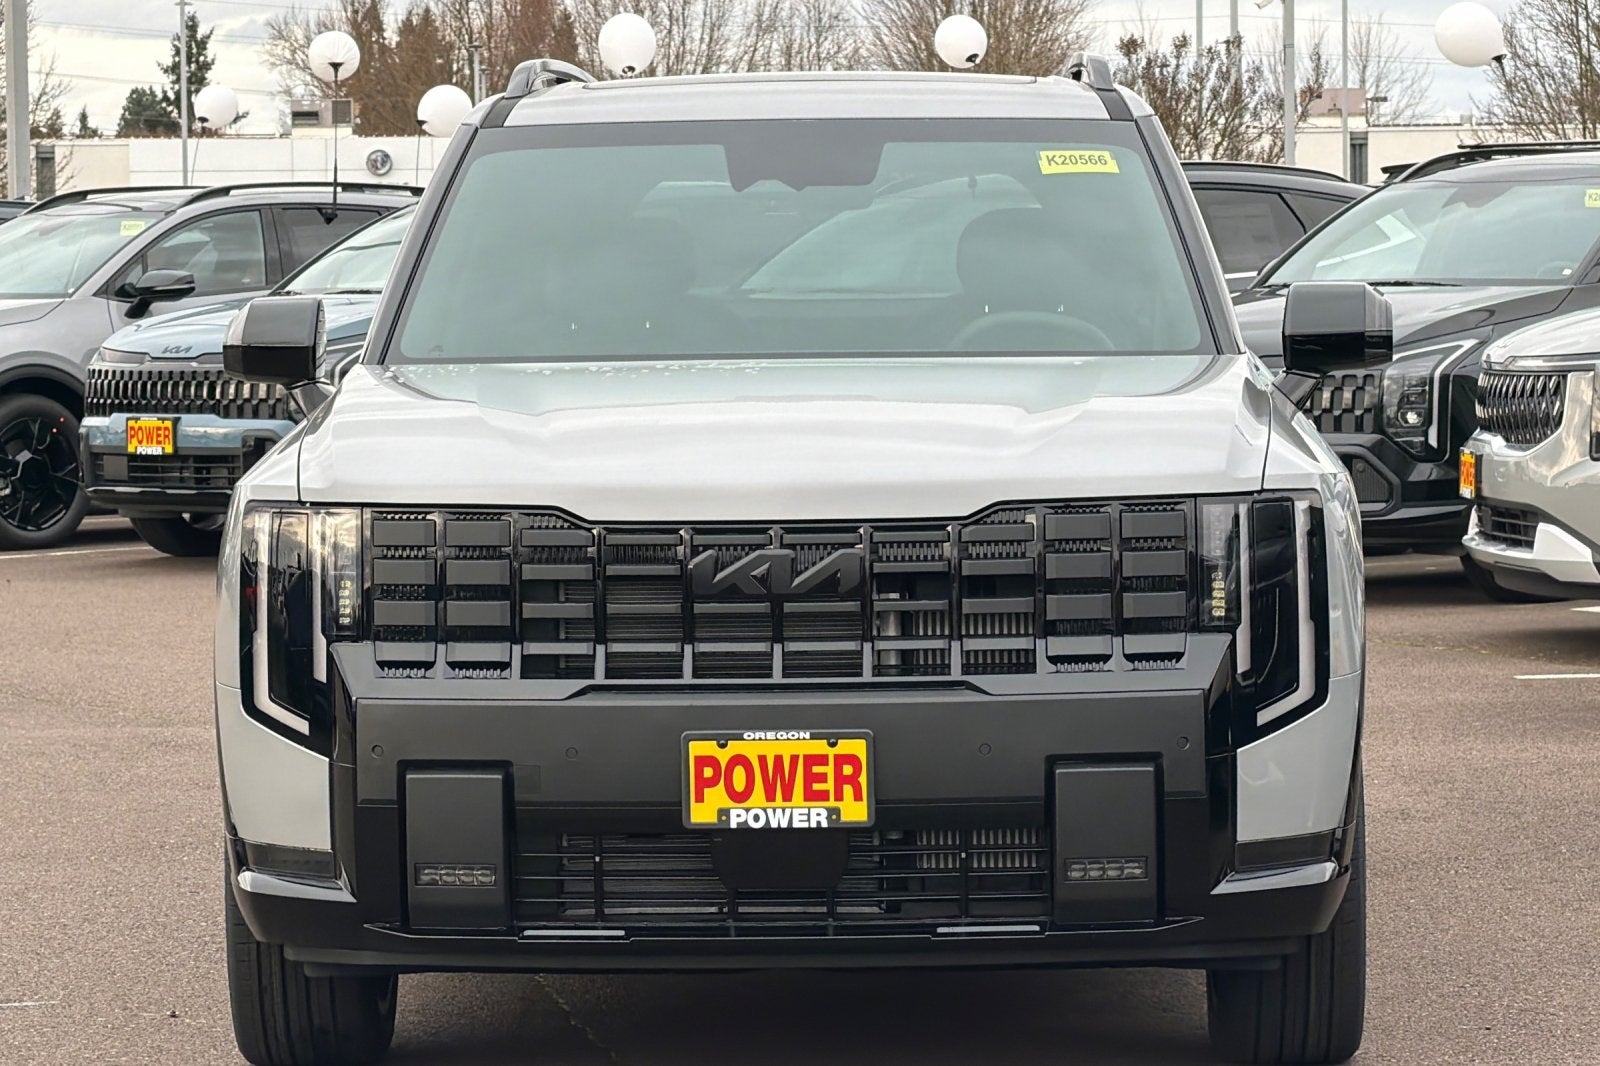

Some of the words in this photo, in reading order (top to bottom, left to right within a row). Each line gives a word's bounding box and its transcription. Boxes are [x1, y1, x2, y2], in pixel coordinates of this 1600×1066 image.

[1046, 154, 1107, 166] K20566
[1588, 192, 1600, 201] K2
[129, 426, 171, 446] POWER
[136, 446, 162, 455] POWER
[688, 549, 864, 594] KIA
[743, 732, 810, 740] OREGON
[694, 754, 863, 804] POWER
[729, 808, 828, 829] POWER
